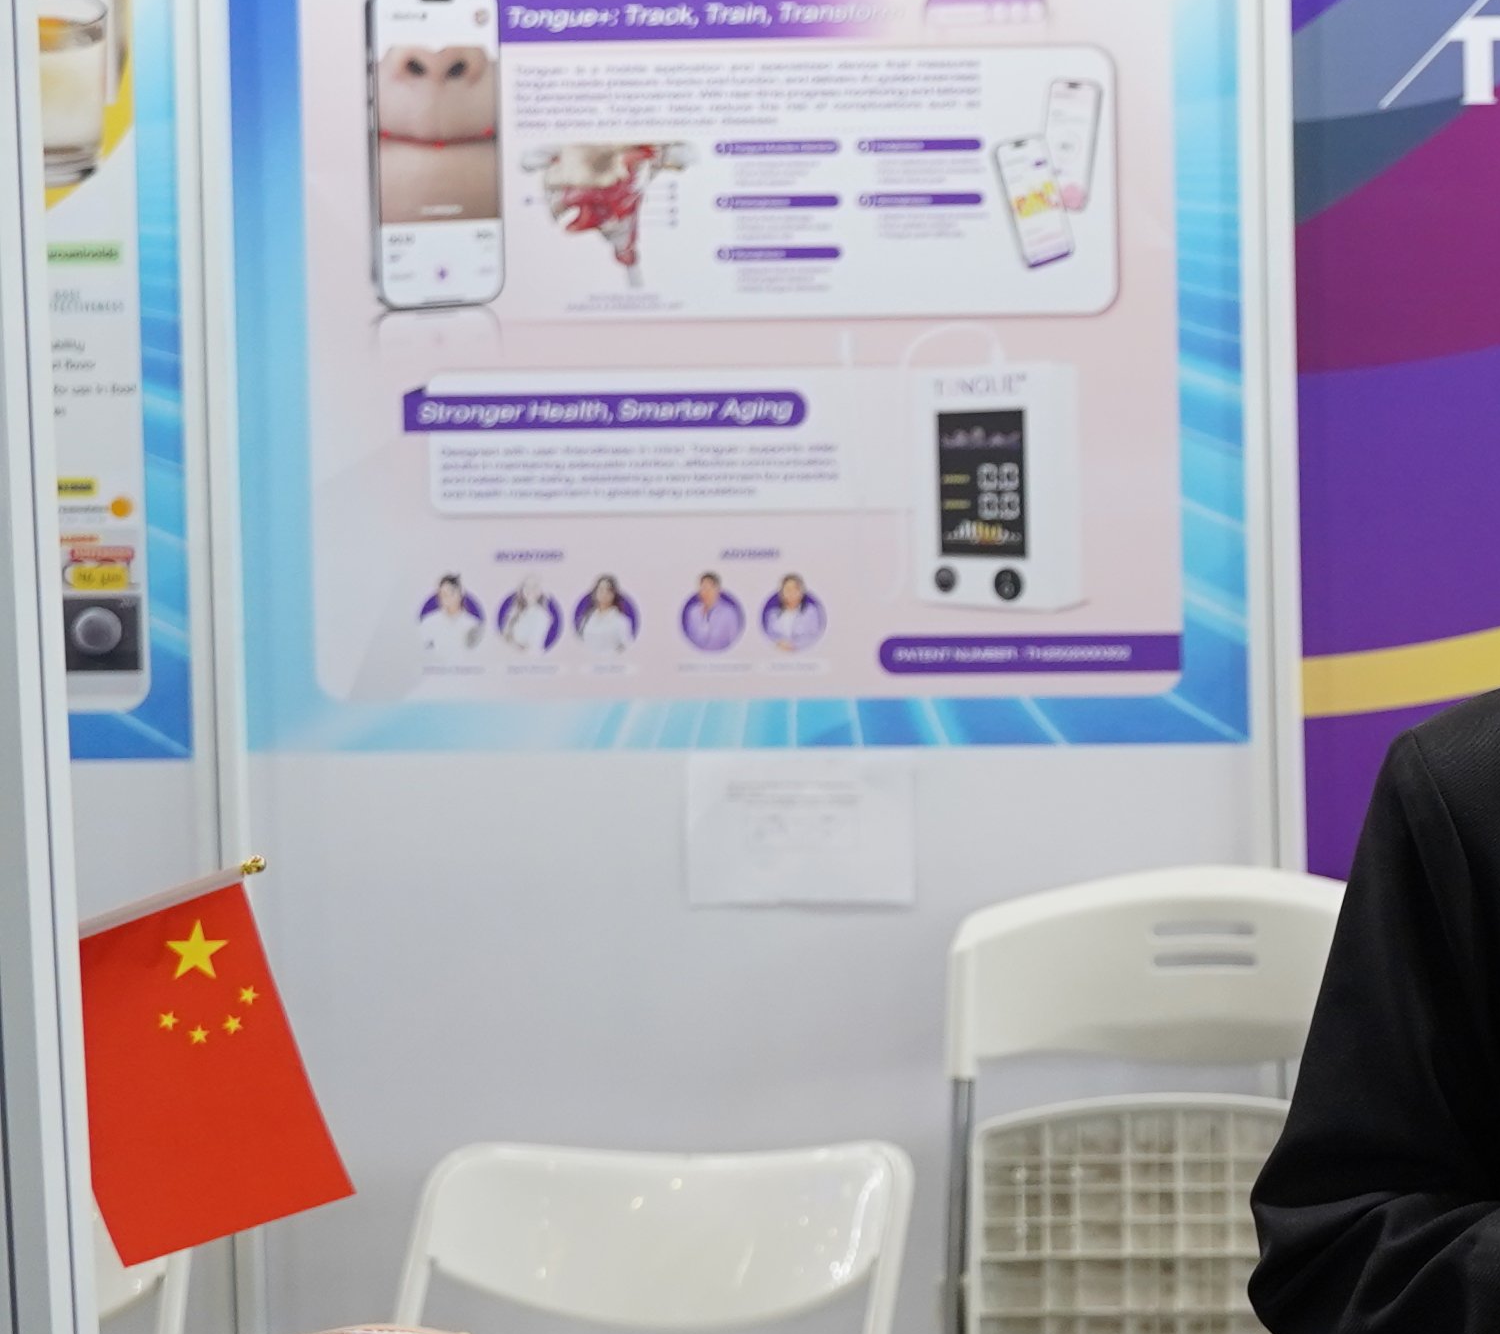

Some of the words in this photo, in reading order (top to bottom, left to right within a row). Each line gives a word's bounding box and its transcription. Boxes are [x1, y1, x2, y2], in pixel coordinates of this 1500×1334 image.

[418, 399, 526, 429] Stronger
[616, 398, 717, 422] Smarter
[718, 396, 795, 426] Aging
